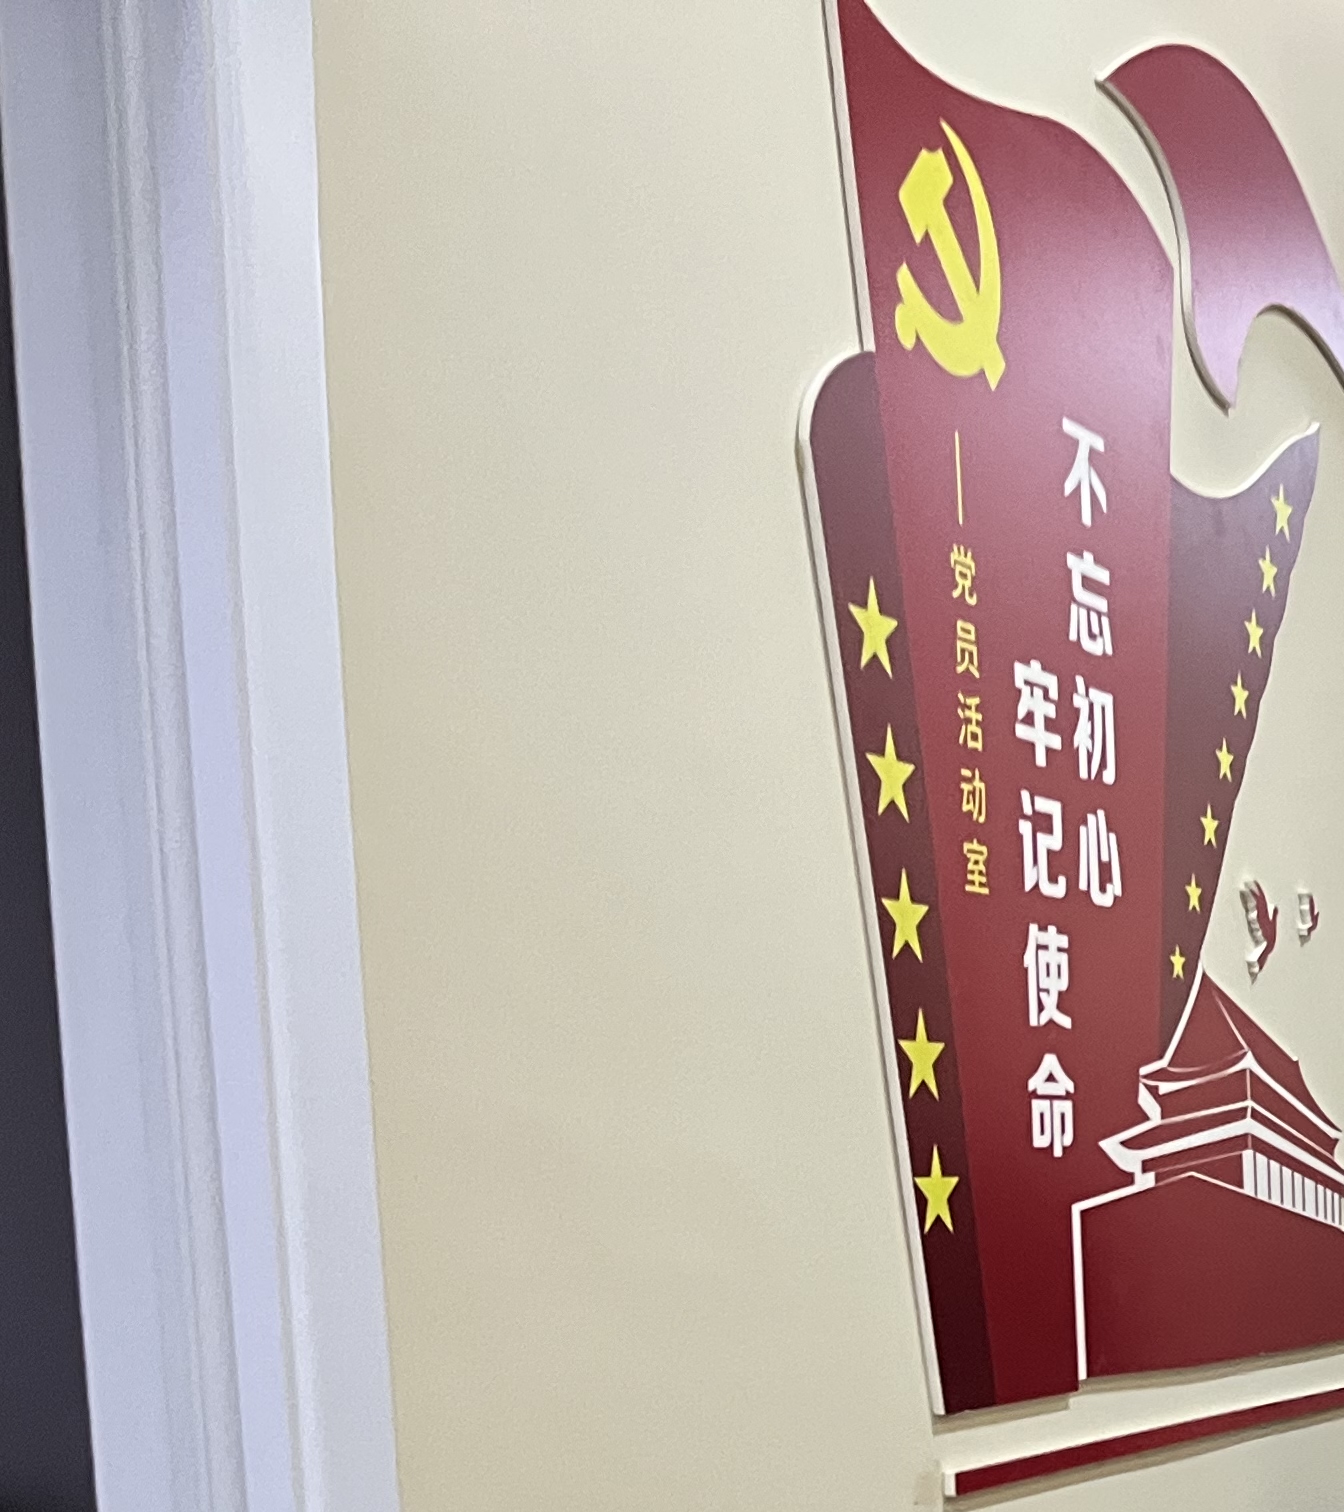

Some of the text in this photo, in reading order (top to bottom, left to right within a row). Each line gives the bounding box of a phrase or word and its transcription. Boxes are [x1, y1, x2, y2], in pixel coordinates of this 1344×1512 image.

[1012, 658, 1076, 1158] 牢记使命
[1061, 415, 1123, 908] 不忘初心
